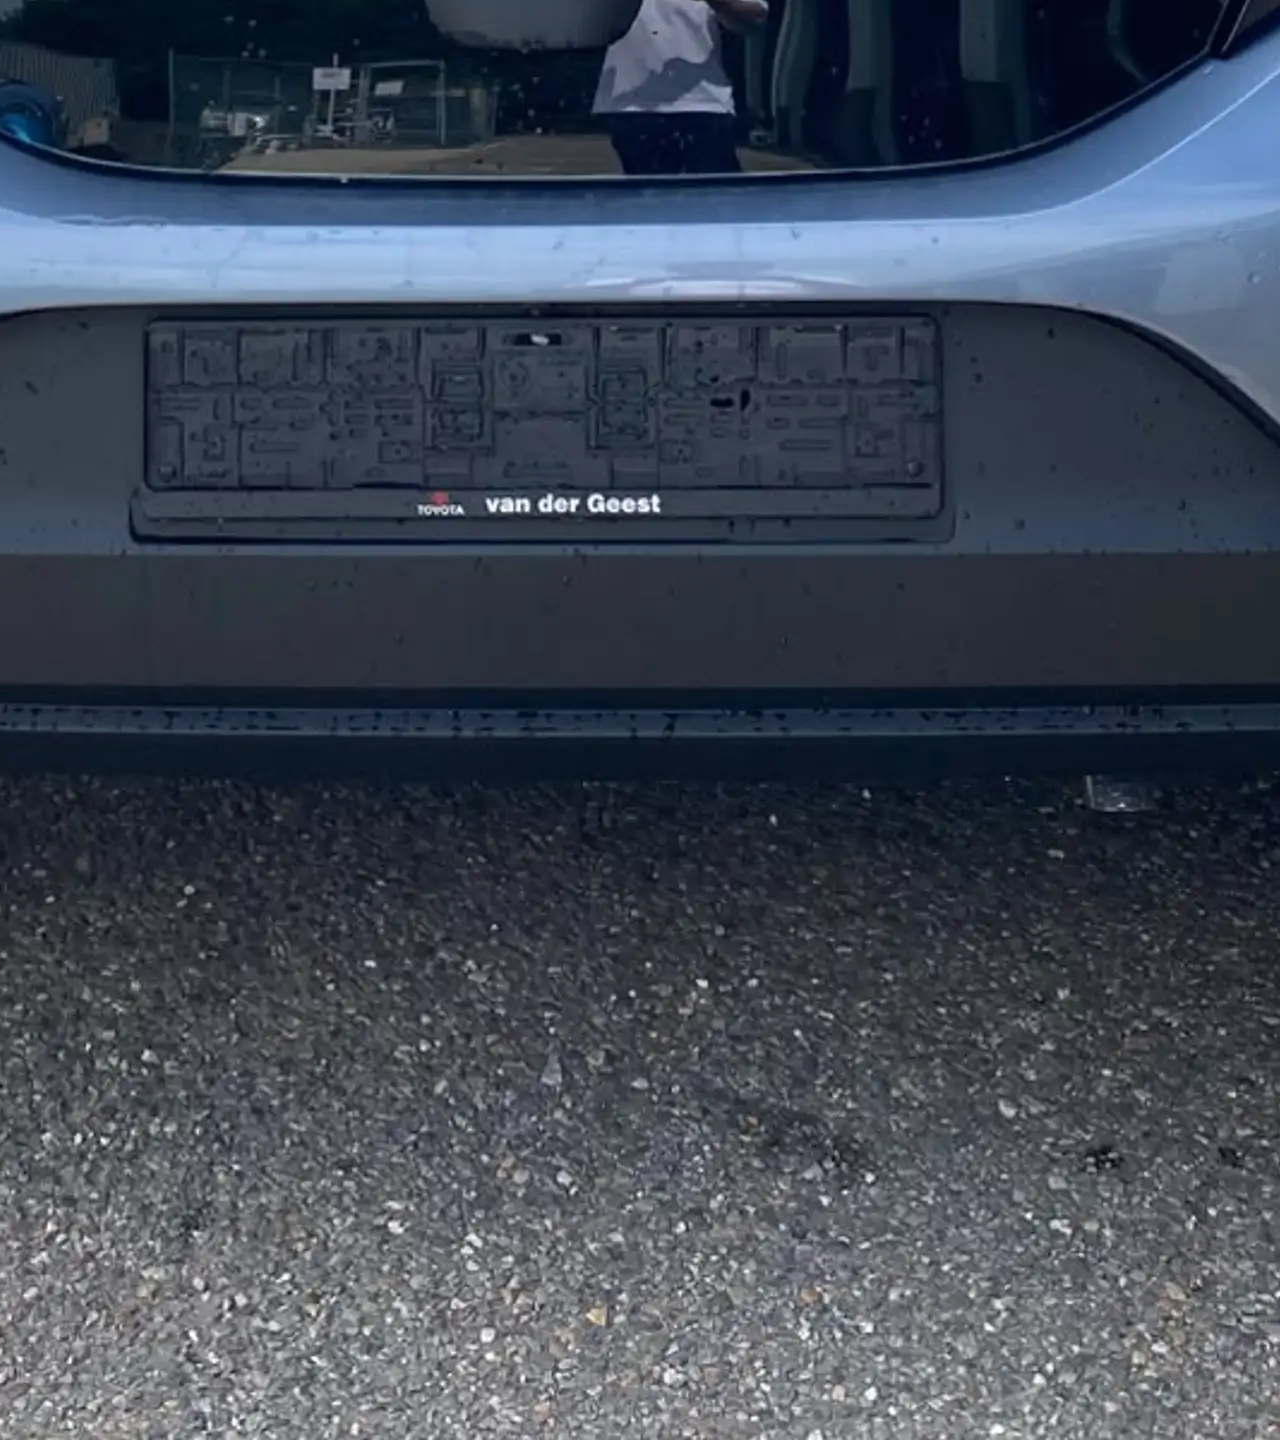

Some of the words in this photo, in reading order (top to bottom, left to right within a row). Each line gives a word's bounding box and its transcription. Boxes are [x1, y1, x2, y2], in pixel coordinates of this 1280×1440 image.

[417, 503, 465, 517] TOYOTA
[484, 496, 531, 513] van
[537, 492, 580, 513] der
[586, 492, 661, 514] Geest
